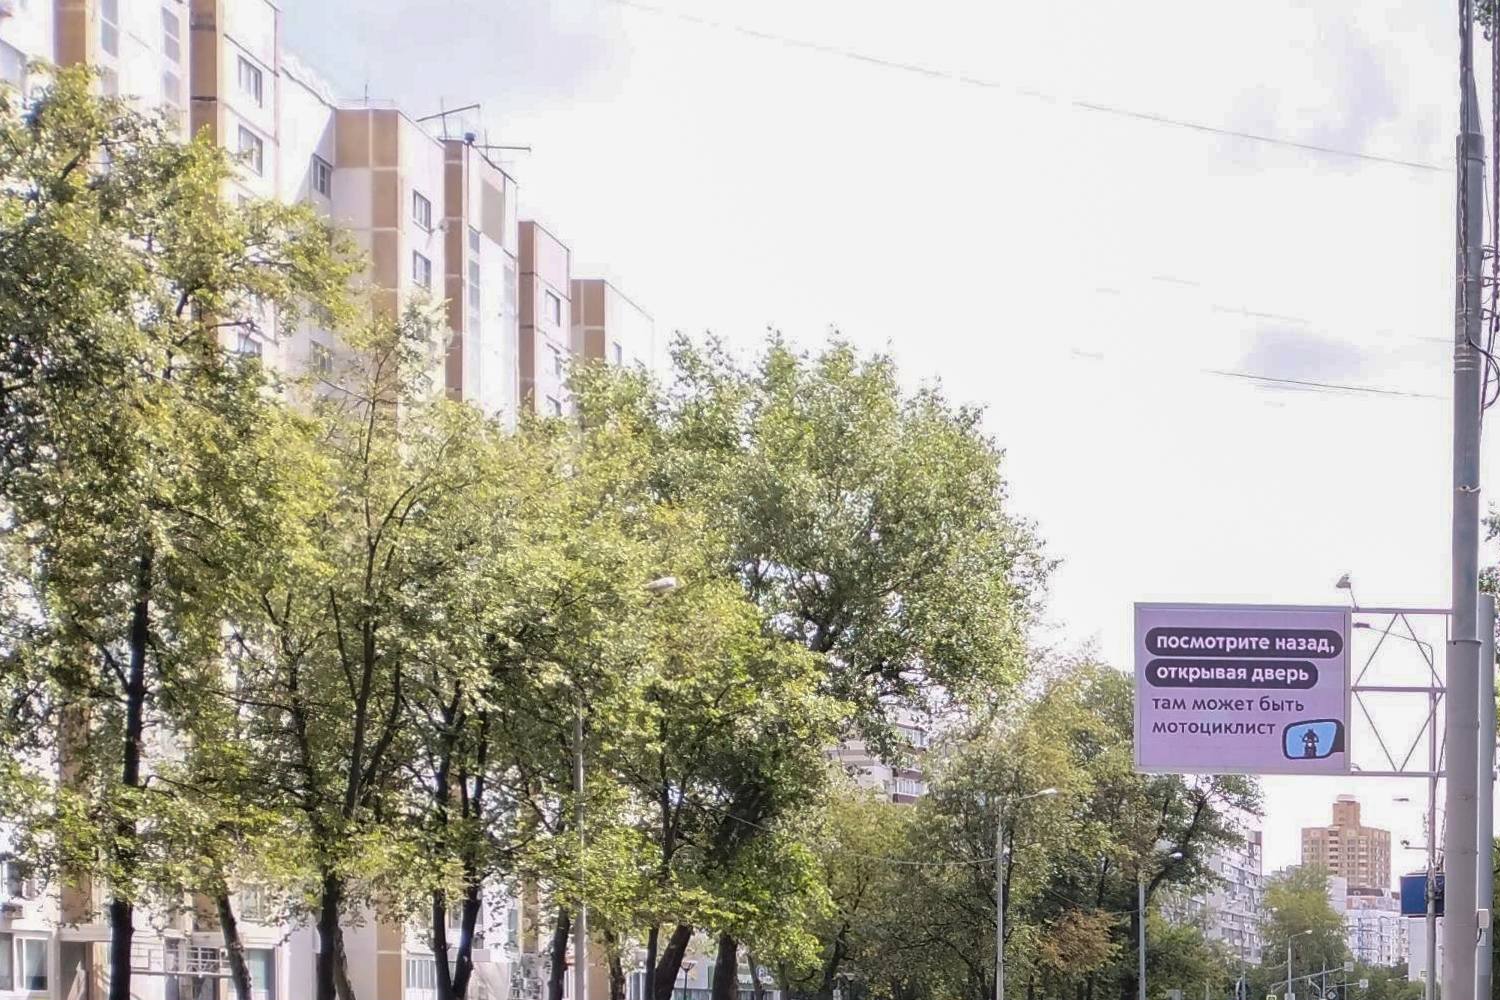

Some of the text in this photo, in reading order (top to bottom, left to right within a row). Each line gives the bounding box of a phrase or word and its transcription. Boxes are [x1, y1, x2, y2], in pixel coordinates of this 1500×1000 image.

[1156, 635, 1335, 652] посмотрите назад,
[1157, 667, 1309, 684] открывая дверь
[1152, 696, 1304, 712] там может быть
[1152, 721, 1276, 737] мотоциклист
